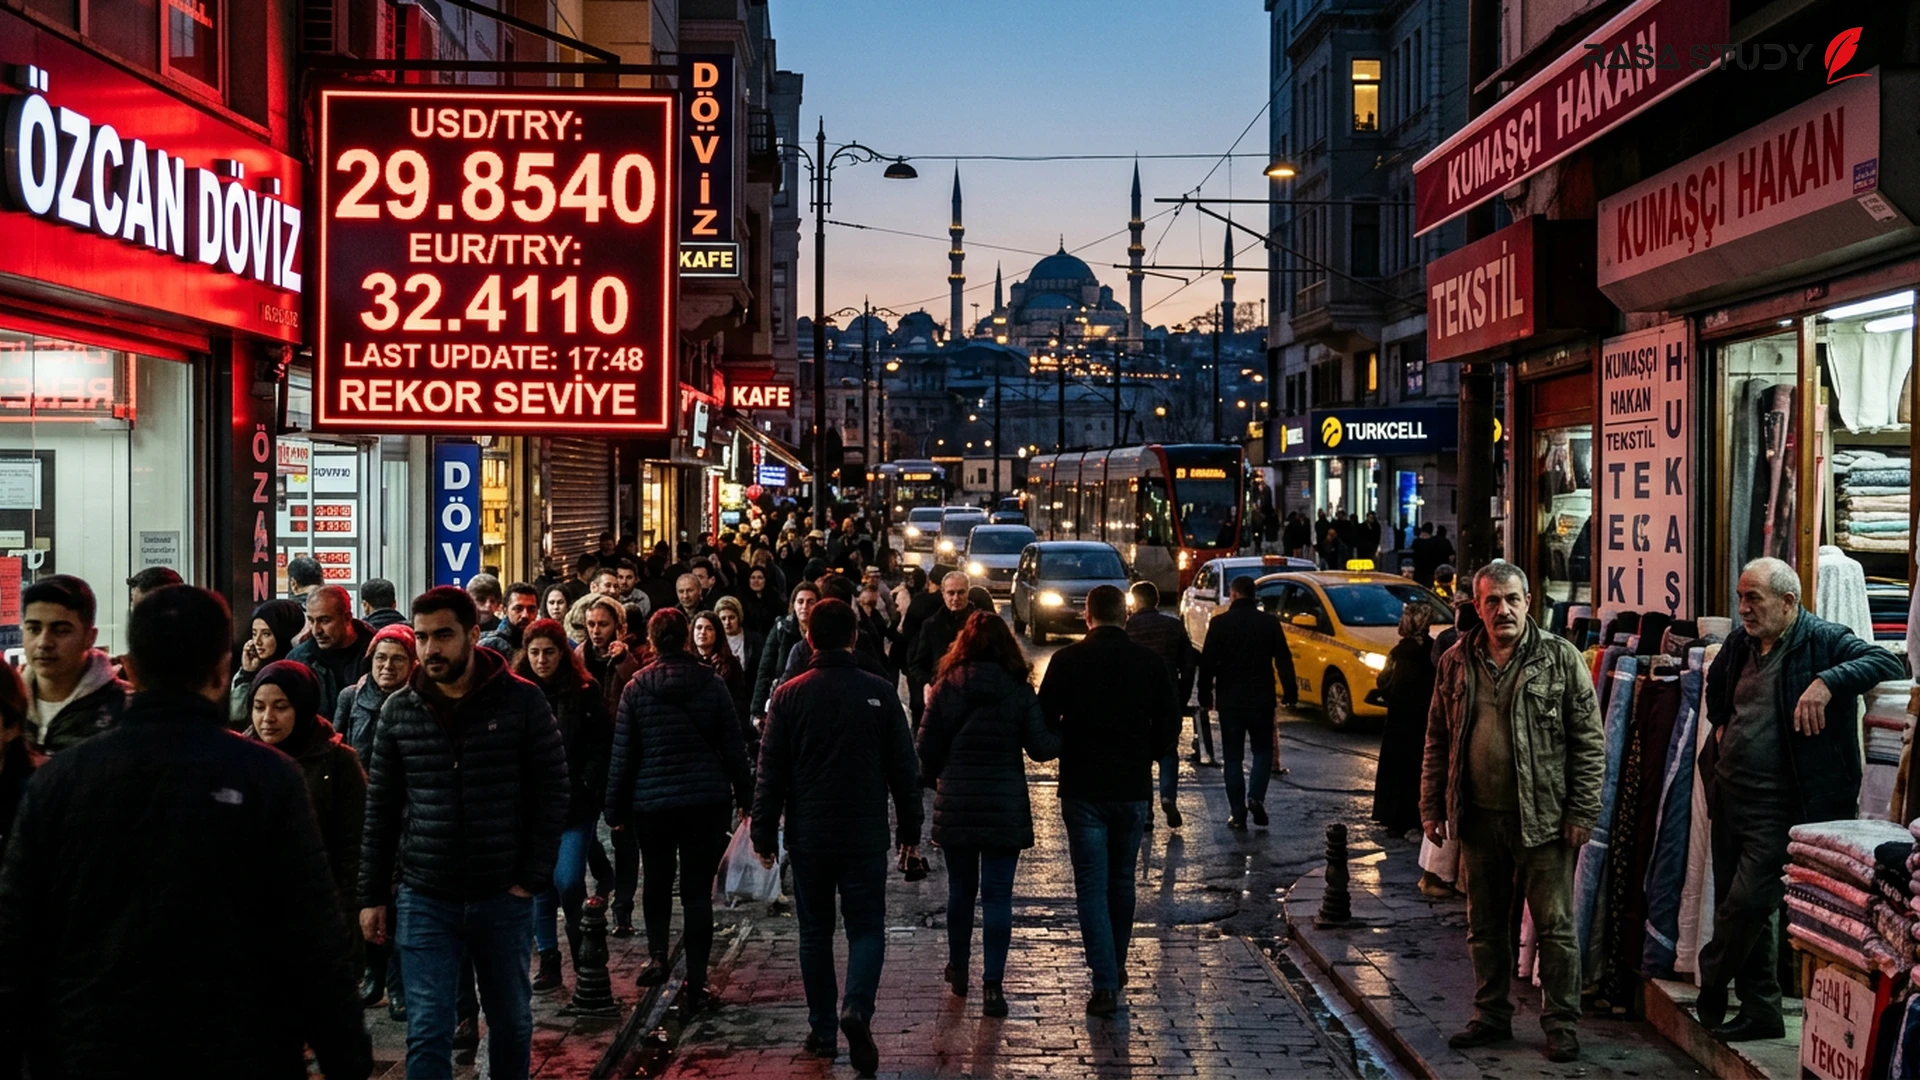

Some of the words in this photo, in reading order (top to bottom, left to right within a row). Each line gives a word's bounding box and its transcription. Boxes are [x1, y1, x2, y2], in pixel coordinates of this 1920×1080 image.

[411, 107, 582, 140] USD/TRY:
[1448, 101, 1542, 205] KUMAŞÇI
[1556, 20, 1657, 140] HAKAN
[17, 65, 185, 257] ÖZCAN
[199, 159, 301, 293] DÖVİZ
[335, 148, 656, 224] 29.8540
[1617, 161, 1725, 264] KUMAŞÇI
[1737, 105, 1845, 219] HAKAN
[409, 233, 581, 265] EUR/TRY:
[680, 250, 733, 269] KAFE
[360, 272, 629, 335] 32.4110
[1432, 240, 1524, 340] TEKSTİL
[344, 343, 422, 369] LAST
[430, 344, 557, 371] UPDATE:
[568, 346, 643, 371] 17:48
[1605, 346, 1657, 381] KUMAŞÇI
[339, 378, 483, 415] REKOR
[493, 374, 636, 415] SEVİYE
[732, 386, 791, 407] KAFE
[1610, 386, 1651, 416] HAKAN
[1346, 421, 1428, 441] TURKCELL
[1606, 425, 1656, 452] TEKSTİL
